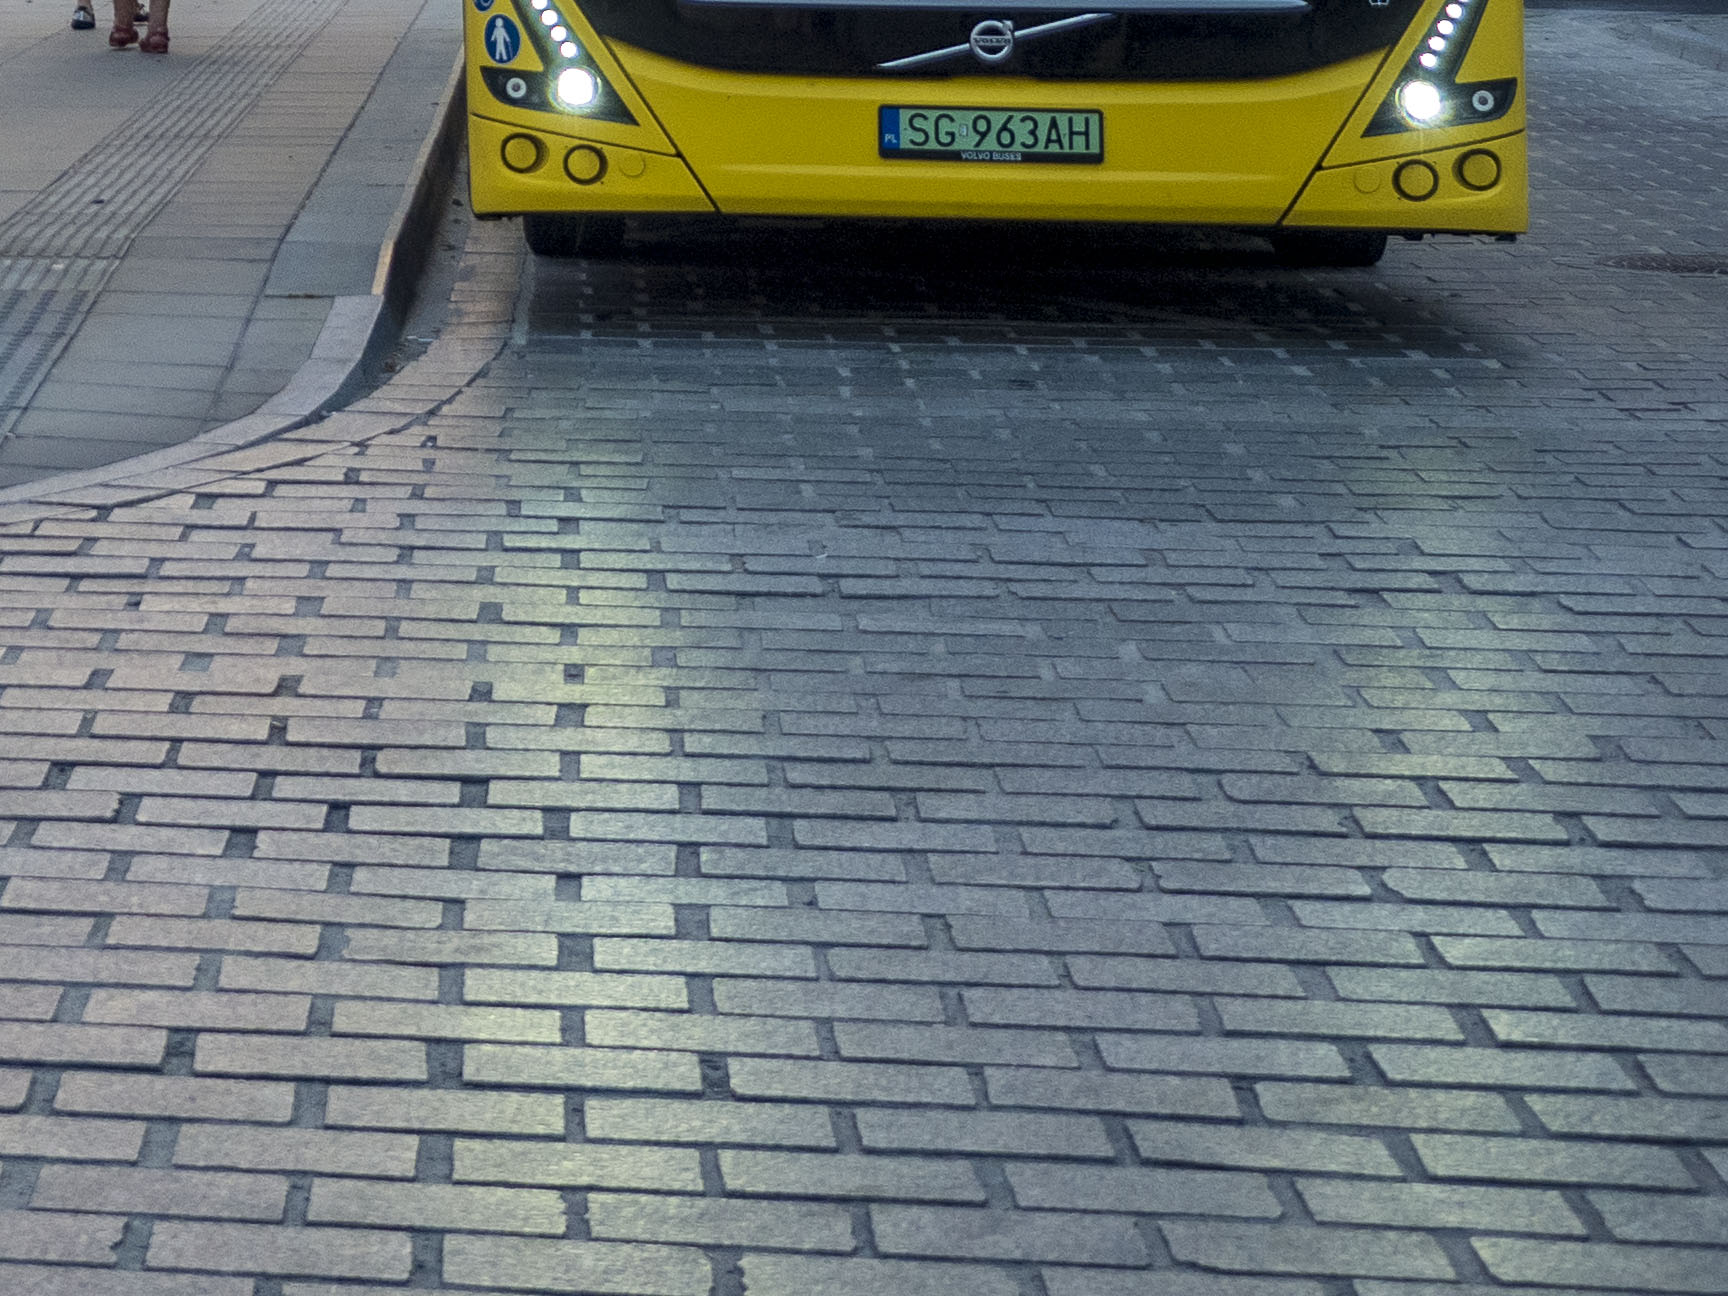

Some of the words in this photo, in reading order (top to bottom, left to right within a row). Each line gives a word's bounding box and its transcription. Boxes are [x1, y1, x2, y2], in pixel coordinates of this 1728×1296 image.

[972, 36, 1011, 46] VOLVO
[884, 133, 898, 144] PL
[907, 112, 957, 148] SG
[971, 113, 1091, 151] 963AH
[960, 151, 991, 161] VOLVO
[992, 152, 1022, 161] BUSES
